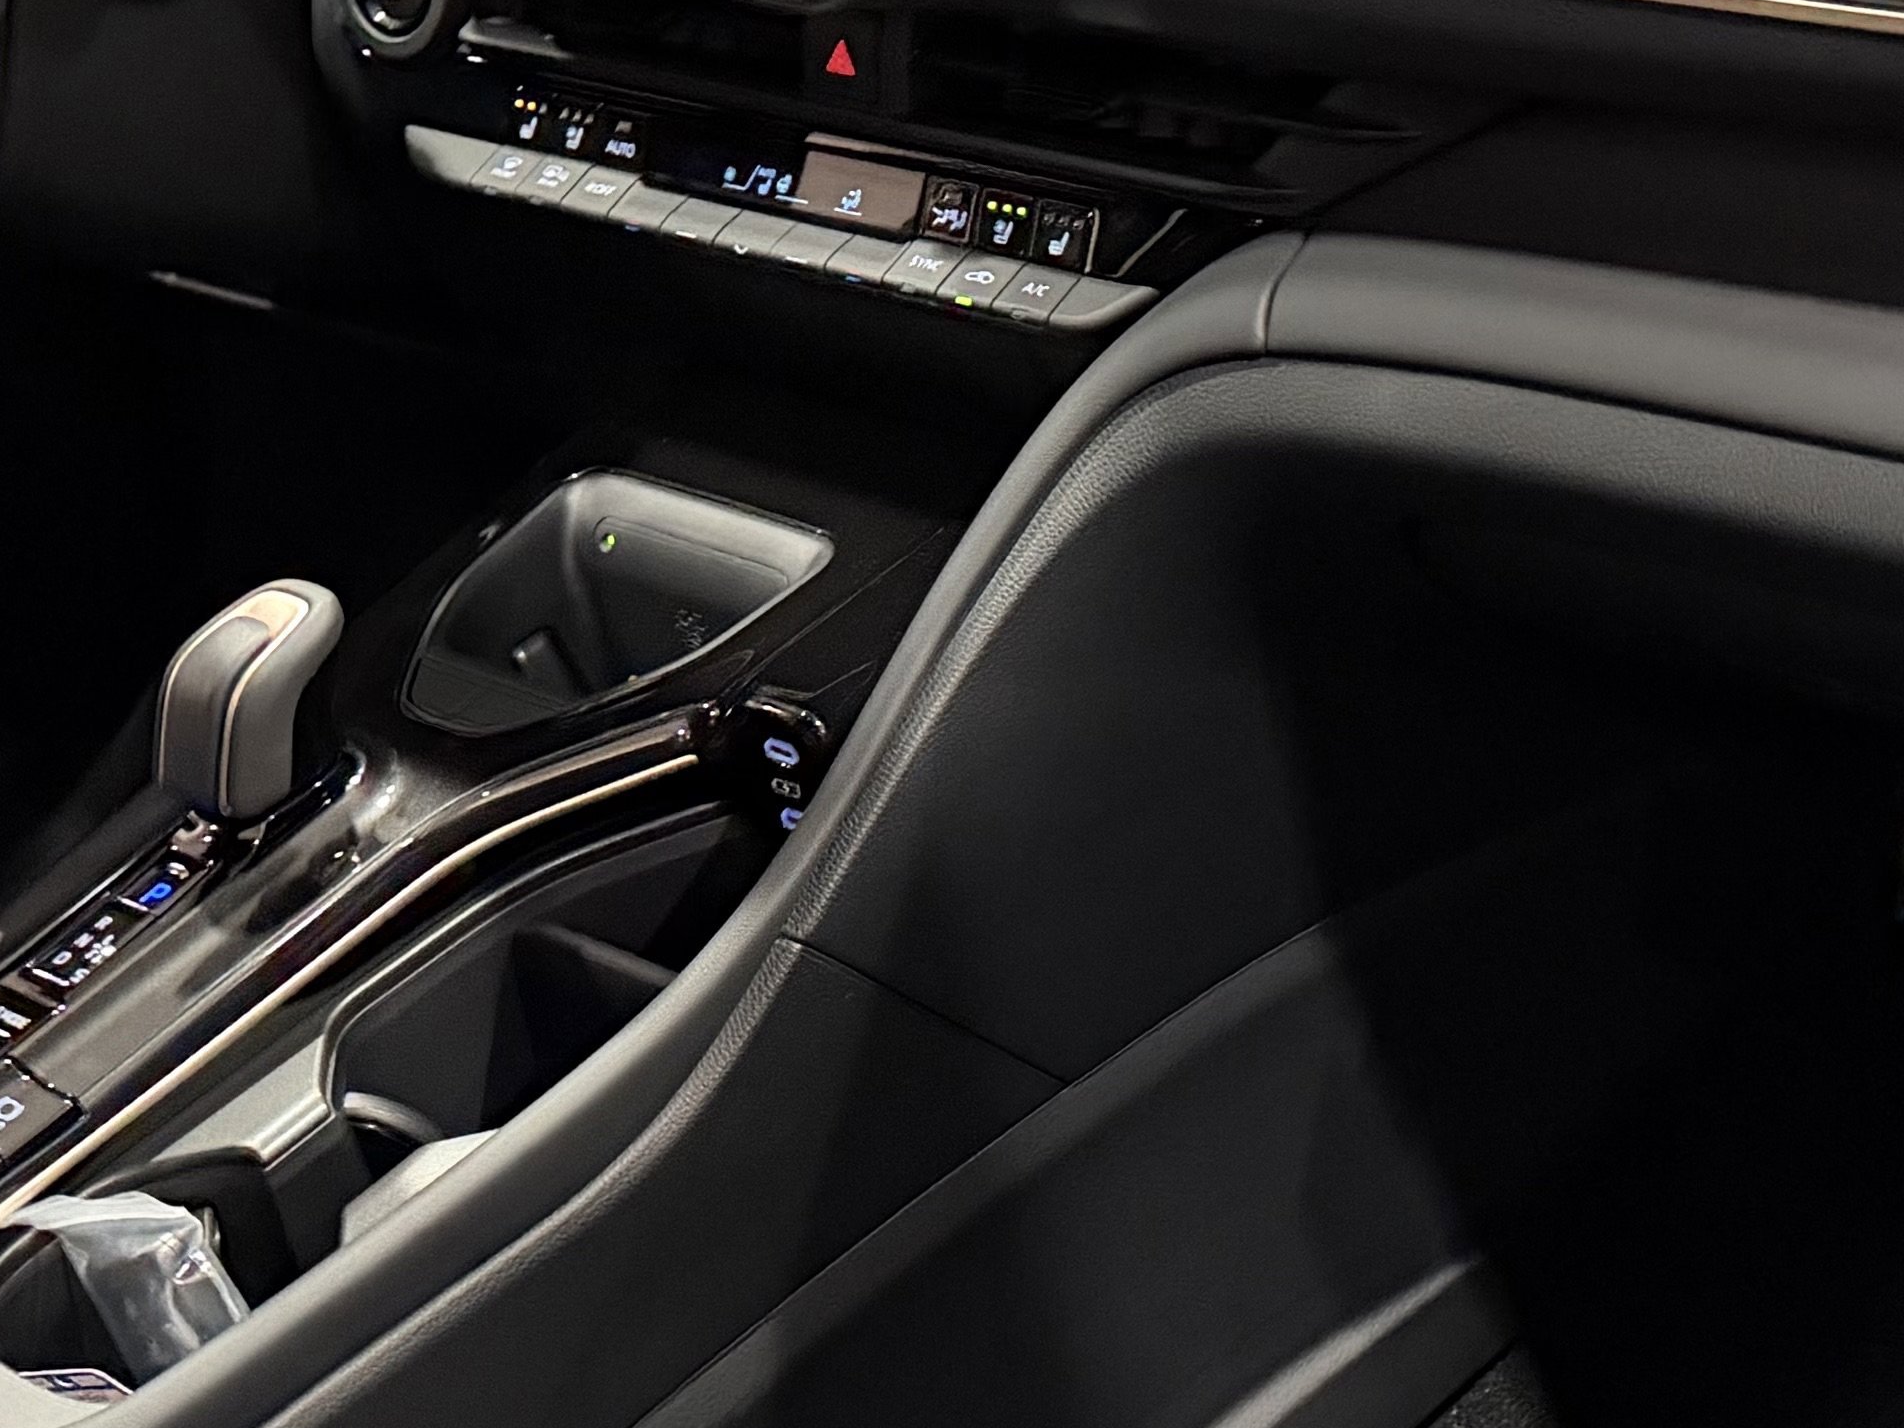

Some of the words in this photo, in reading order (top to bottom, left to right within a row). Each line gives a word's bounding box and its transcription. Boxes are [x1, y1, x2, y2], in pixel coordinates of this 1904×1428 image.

[604, 139, 637, 159] AUTO
[908, 254, 945, 271] SYNC
[1021, 281, 1051, 298] A/C
[138, 882, 173, 903] P
